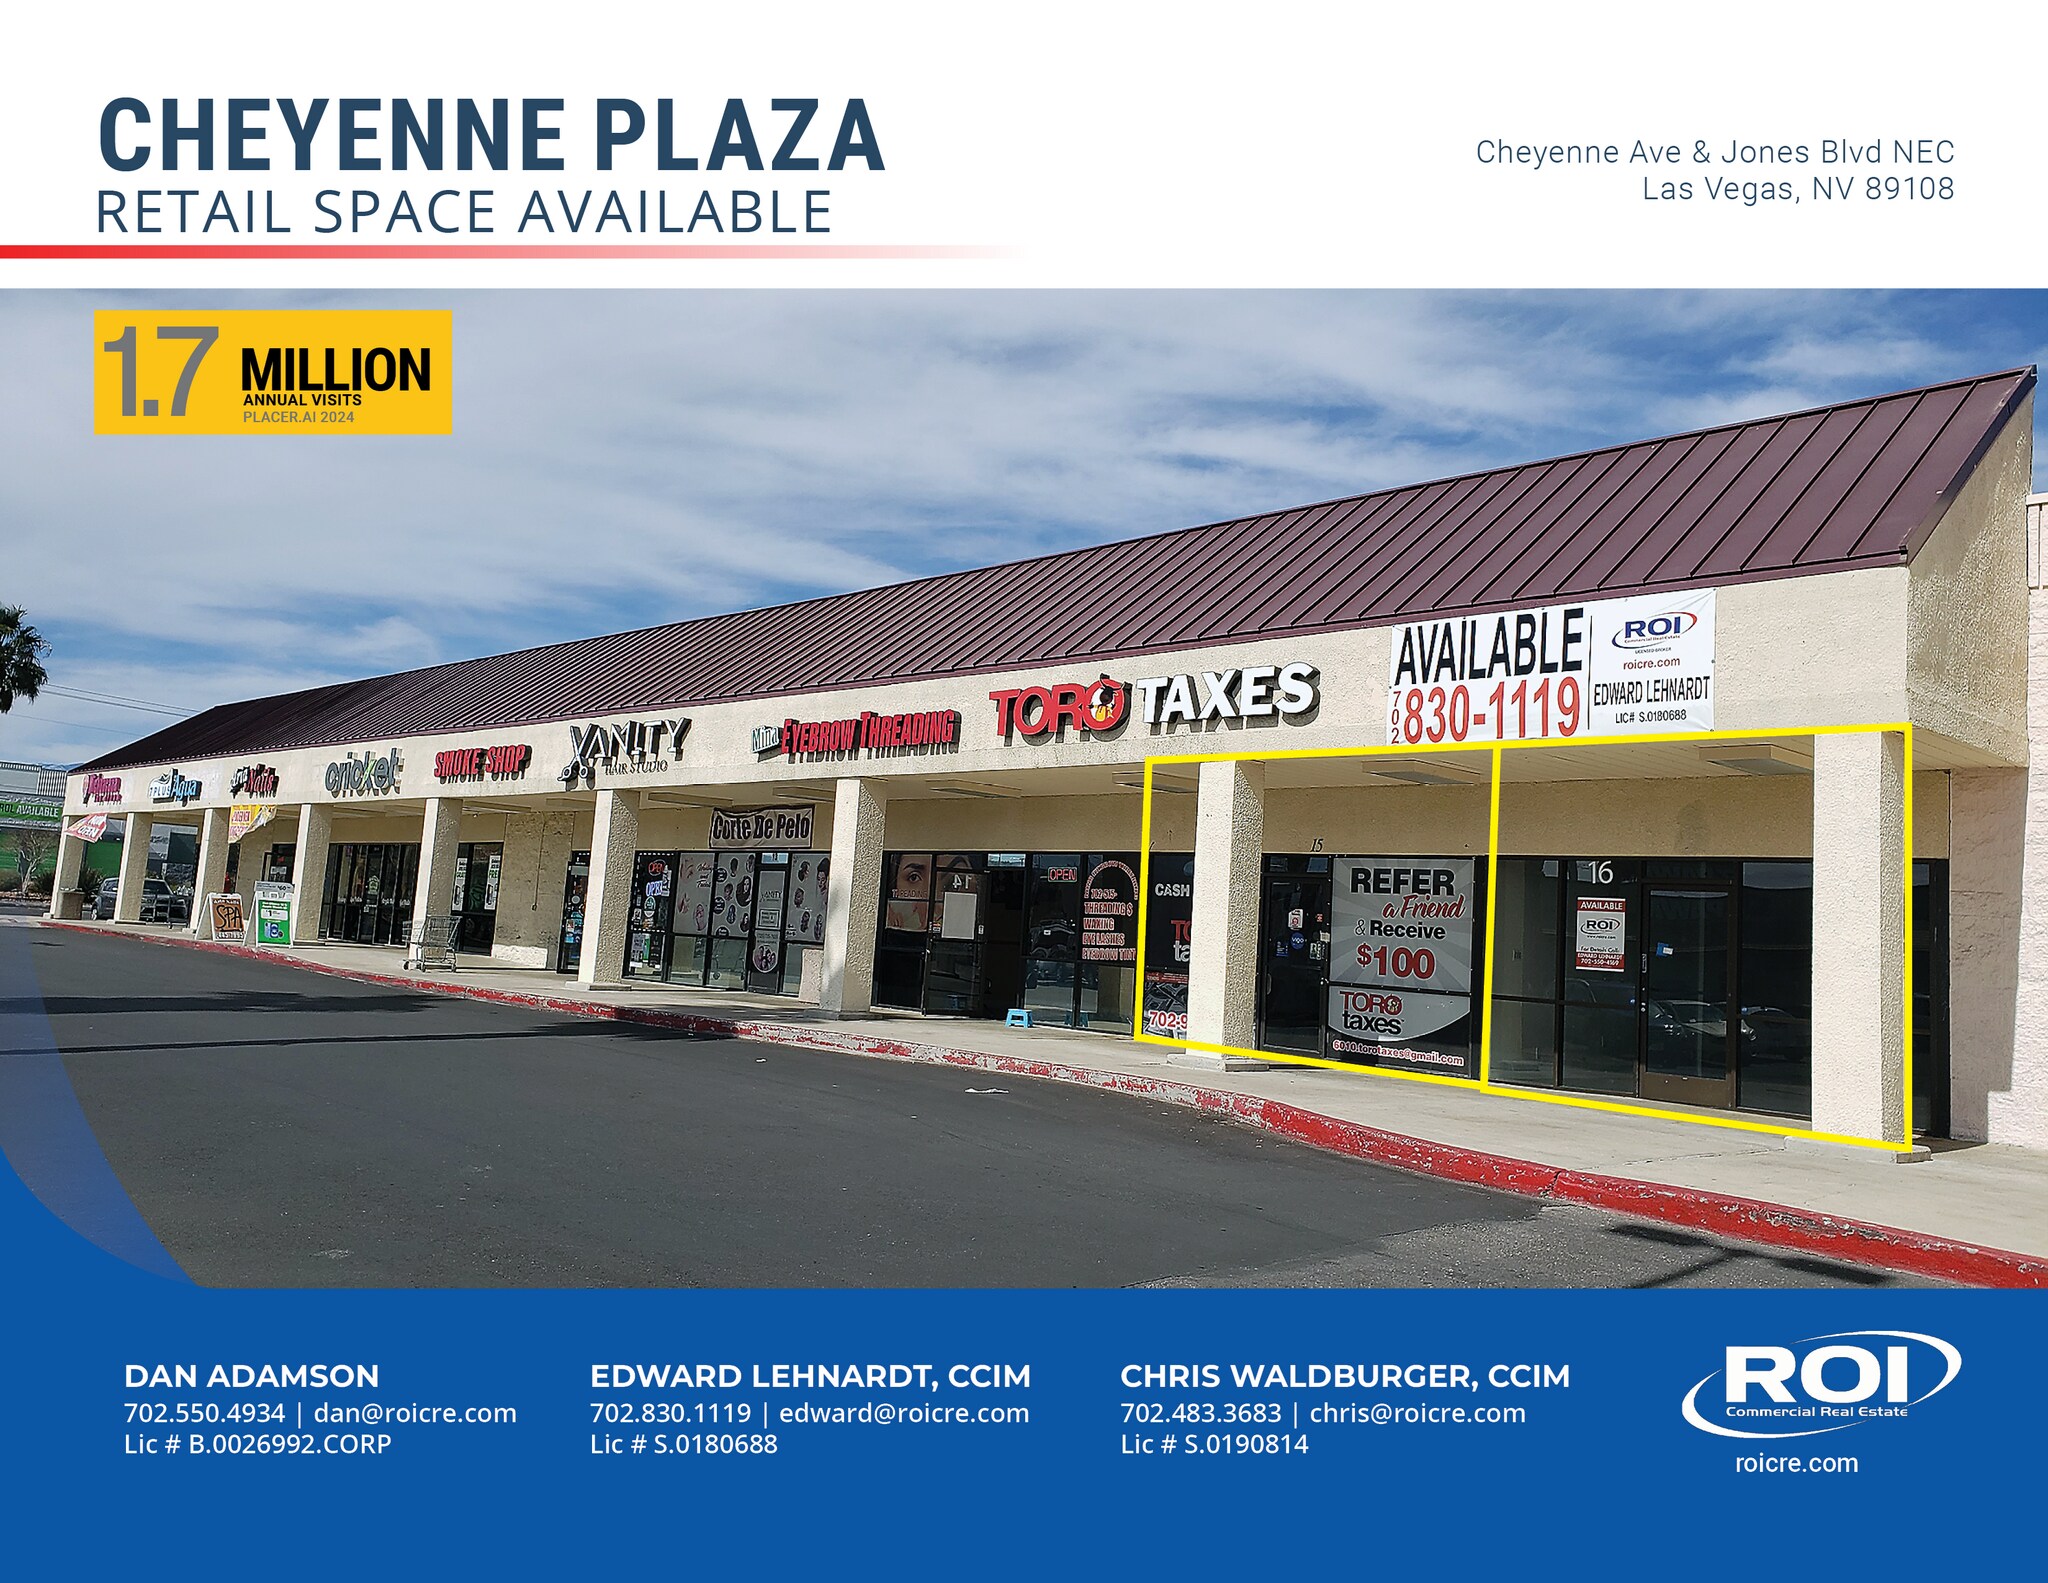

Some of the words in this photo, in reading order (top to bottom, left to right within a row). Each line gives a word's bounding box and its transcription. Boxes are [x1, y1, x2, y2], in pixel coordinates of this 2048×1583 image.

[1625, 616, 1681, 638] ROI
[1395, 608, 1584, 685] AVAILABLE
[1623, 658, 1681, 670] roicre.com
[989, 675, 1126, 737] TORO
[1137, 661, 1315, 724] TAXES
[1594, 681, 1643, 706] EDWARD
[1646, 676, 1710, 703] LEHNARDT
[1403, 676, 1581, 745] 830-1119
[1615, 711, 1635, 724] LIC#
[1639, 709, 1687, 722] S.0180688
[568, 717, 692, 764] VANITY
[751, 726, 780, 751] Mina
[781, 718, 856, 754] EYEBROW
[860, 708, 956, 748] THREADING
[325, 747, 399, 792] cricket
[434, 748, 482, 778] SMOKE
[485, 744, 527, 773] SHOP
[605, 762, 630, 776] HAIR
[630, 760, 669, 774] STUDIO
[170, 774, 198, 801] Agua
[243, 764, 275, 792] Nails
[16, 805, 59, 818] AVAILABLE
[713, 815, 752, 839] Corte
[753, 815, 774, 839] De
[776, 813, 811, 839] Pelo
[1311, 838, 1323, 853] 15
[1050, 868, 1077, 881] OPEN
[1350, 867, 1455, 896] REFER
[1589, 860, 1614, 885] 16
[1154, 883, 1190, 898] CASH
[215, 905, 243, 930] SPA
[1084, 902, 1126, 915] THREADING
[1382, 901, 1400, 918] a
[1399, 894, 1465, 919] Friend
[1580, 901, 1623, 911] AVAILABLE
[1083, 917, 1115, 931] WAXING
[1354, 919, 1366, 936] &
[1370, 919, 1446, 940] Receive
[1586, 920, 1613, 930] ROI
[1082, 932, 1096, 945] EYE
[1096, 932, 1126, 946] LASHES
[1082, 948, 1119, 961] EYEBROW
[1357, 943, 1436, 980] $100
[1339, 990, 1403, 1016] TORO
[1342, 1010, 1402, 1035] taxes
[1333, 1039, 1464, 1066] 6010.torotaxes@gmail.com
